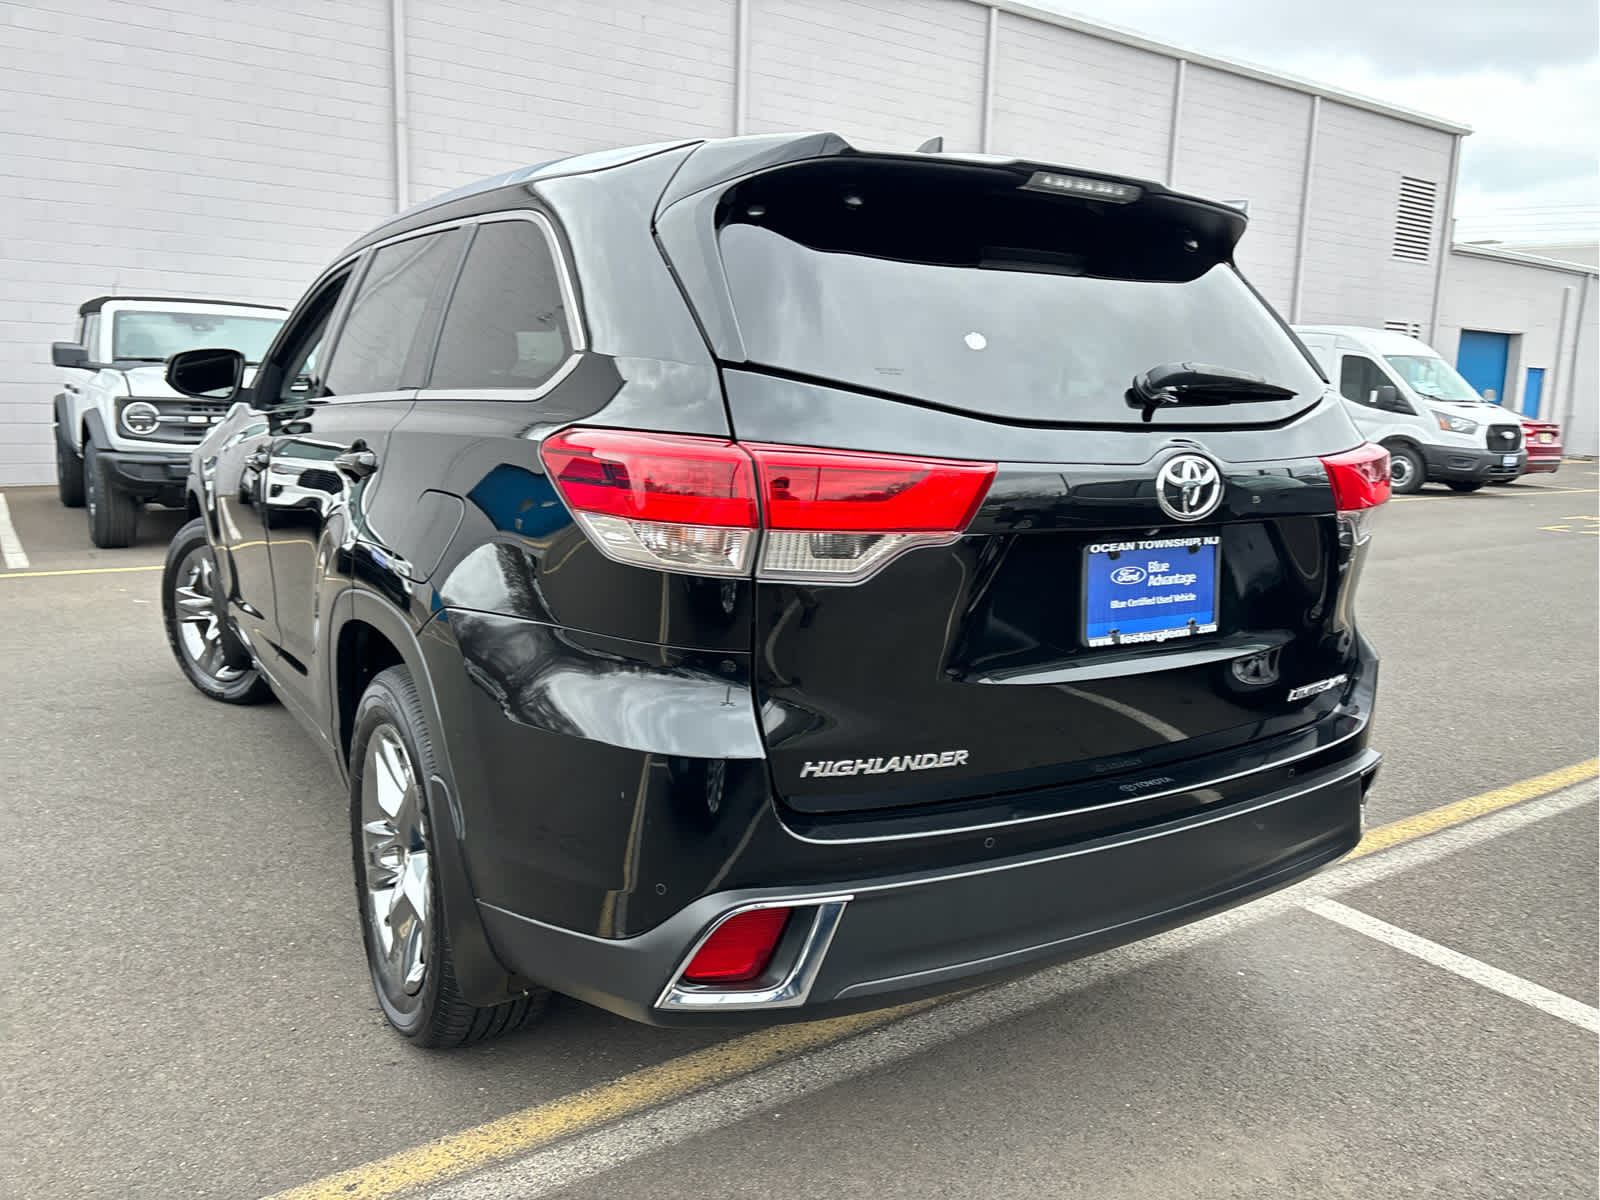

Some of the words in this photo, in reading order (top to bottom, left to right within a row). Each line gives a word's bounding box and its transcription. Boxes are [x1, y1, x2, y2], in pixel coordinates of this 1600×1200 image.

[1090, 541, 1135, 553] OCEAN
[1203, 536, 1220, 545] NJ
[1148, 561, 1169, 573] Blue
[1117, 568, 1141, 582] Ford
[1147, 574, 1197, 586] Advantage
[1110, 599, 1127, 609] Blue
[1127, 596, 1155, 607] Certified
[1156, 595, 1173, 604] Used
[1174, 592, 1197, 602] Vehicle
[799, 749, 969, 779] HIGHLANDER
[1135, 776, 1175, 790] TOYOTA
